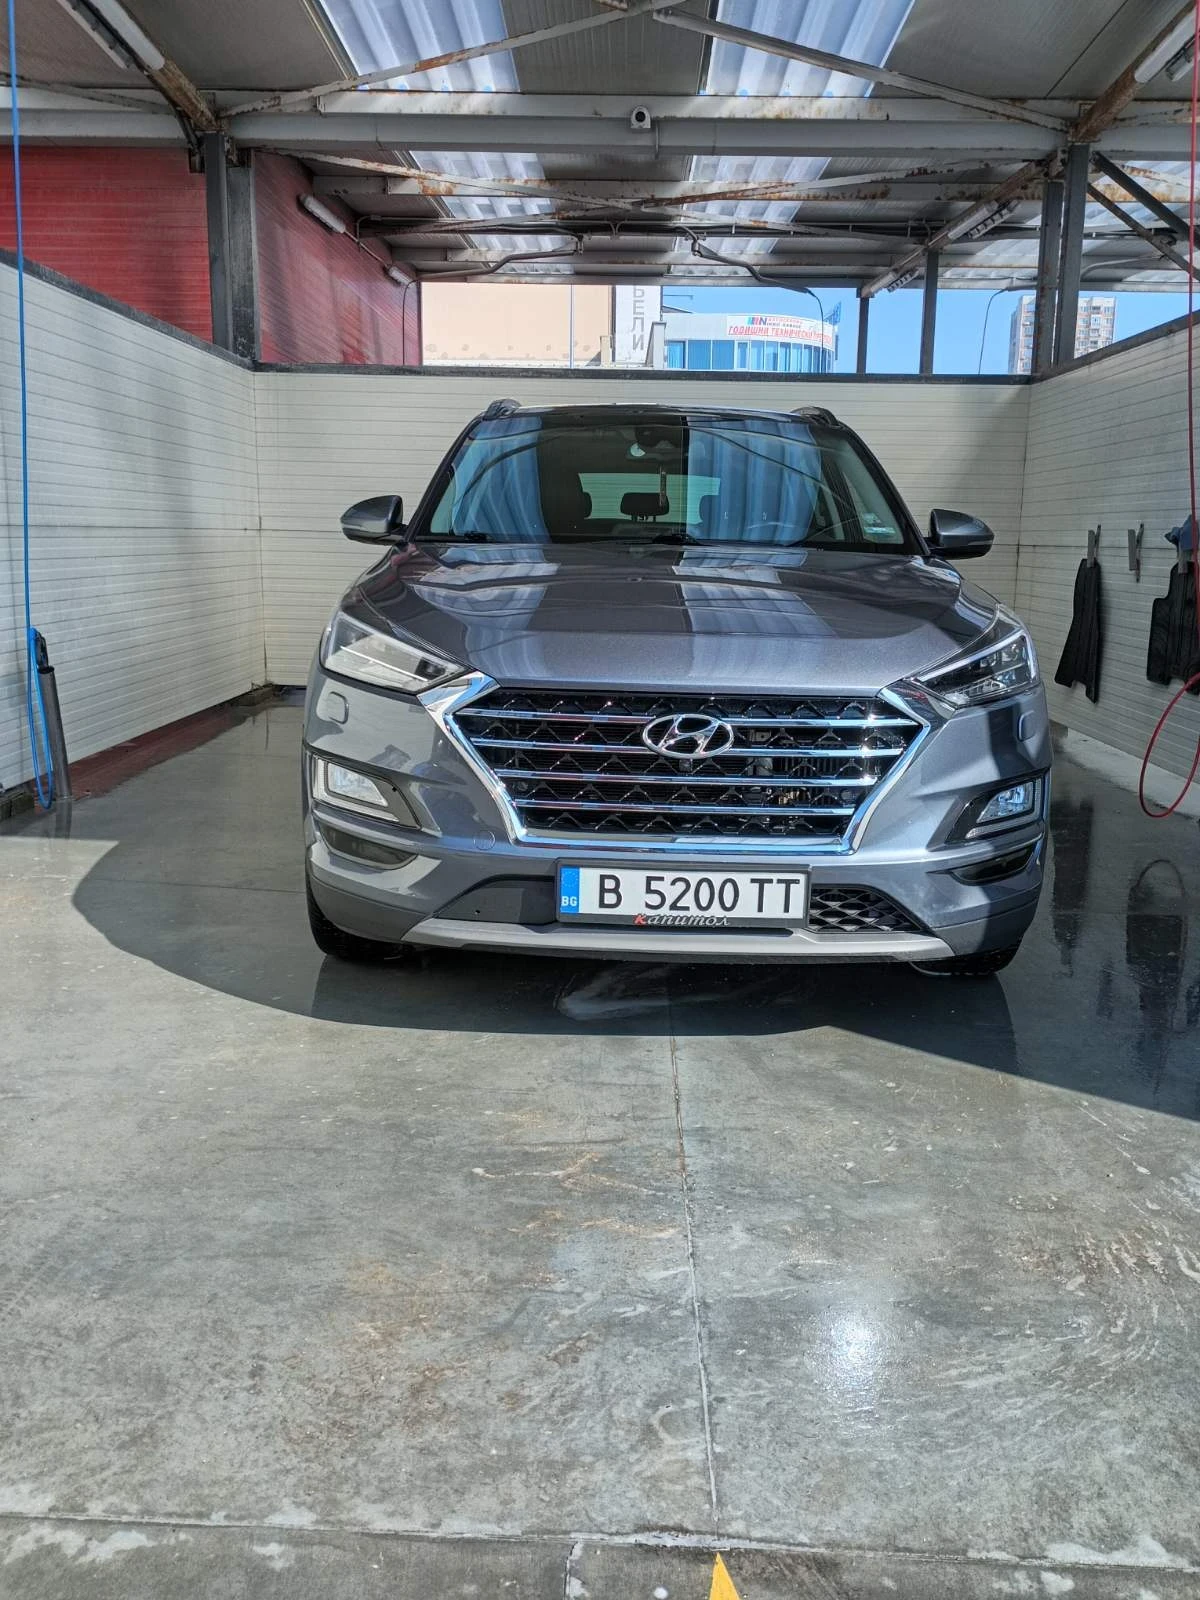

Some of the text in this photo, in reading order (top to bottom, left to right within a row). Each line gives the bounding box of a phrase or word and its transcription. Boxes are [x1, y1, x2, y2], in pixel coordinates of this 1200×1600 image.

[728, 325, 769, 335] ГОДИШНИ
[598, 874, 800, 913] B 5200 TT
[561, 896, 577, 907] BG
